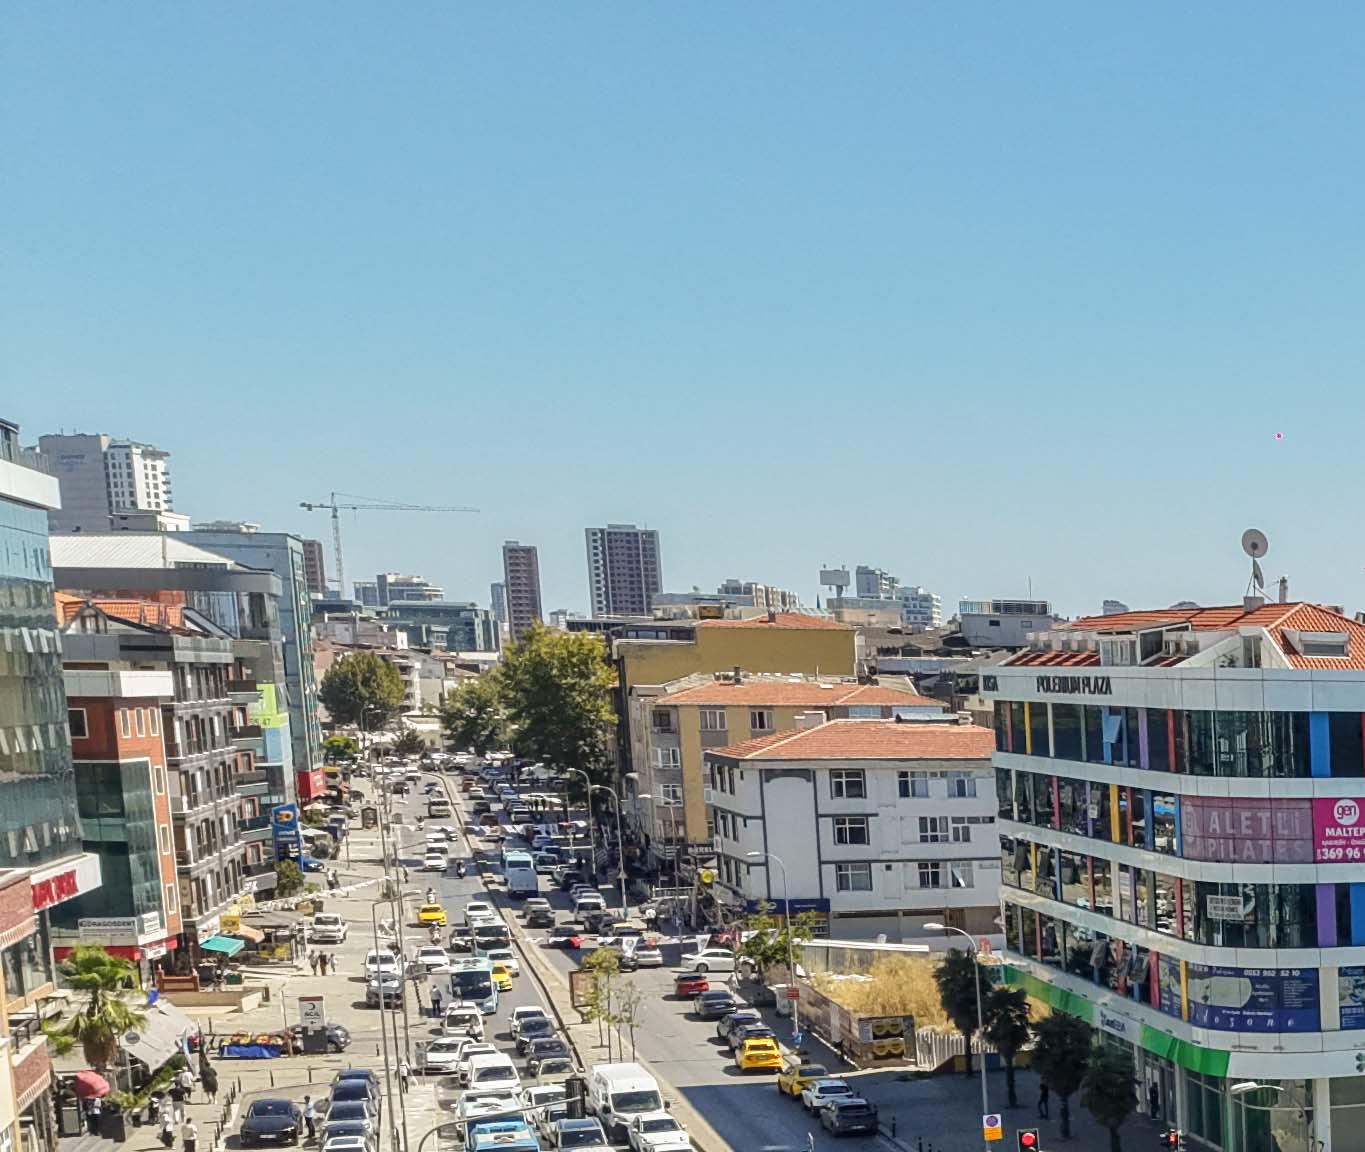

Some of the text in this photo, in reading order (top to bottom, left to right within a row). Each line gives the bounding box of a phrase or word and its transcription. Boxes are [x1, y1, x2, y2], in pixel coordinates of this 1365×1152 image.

[1082, 675, 1112, 695] PLAZA
[1322, 847, 1344, 860] 369
[1346, 847, 1361, 859] 96
